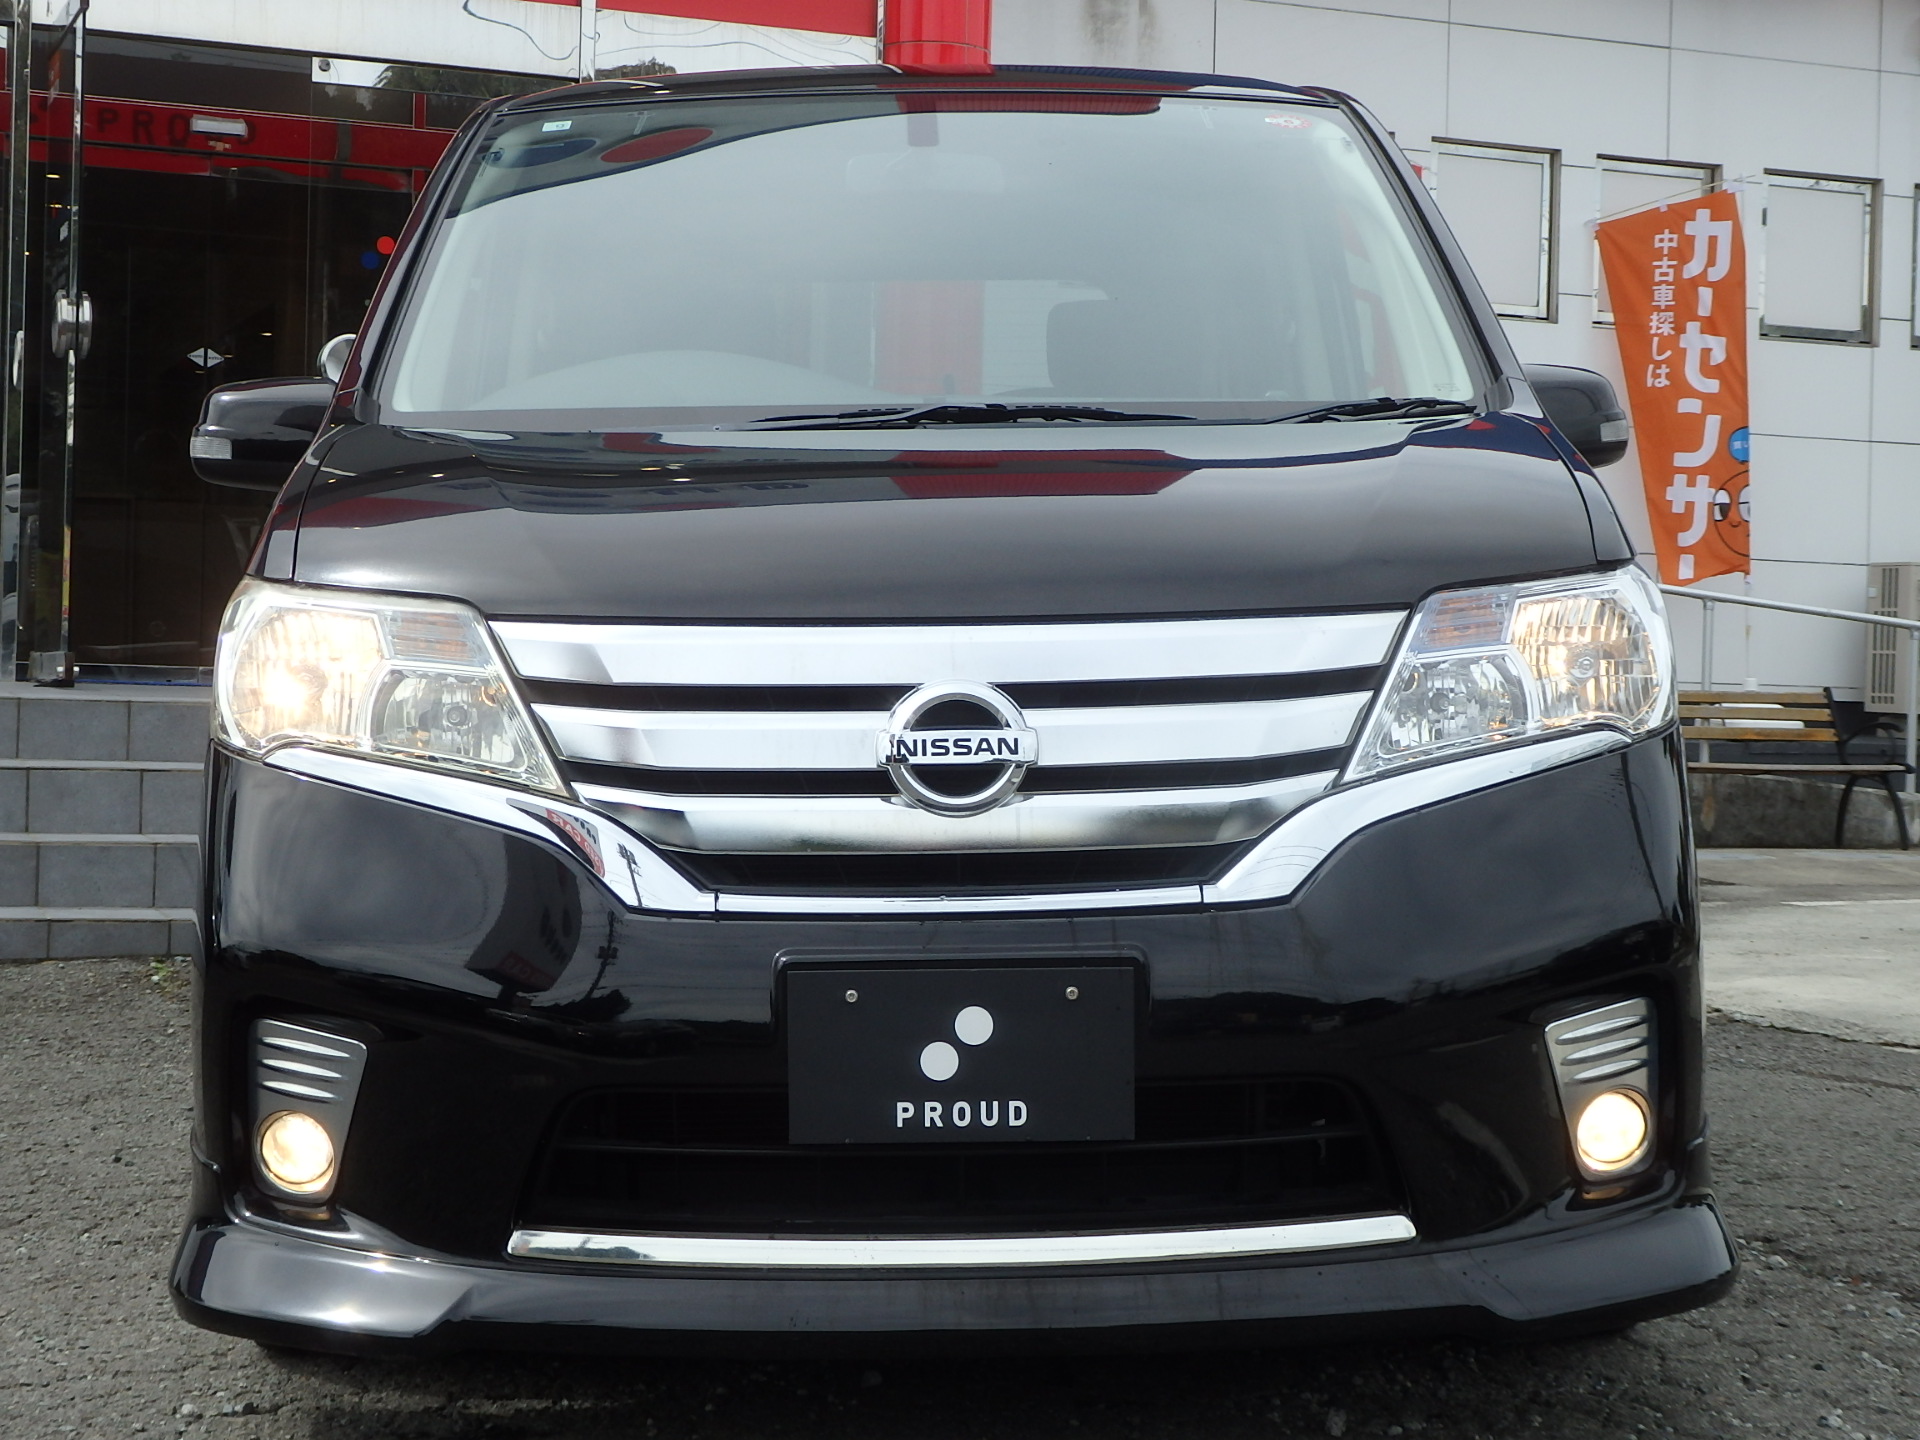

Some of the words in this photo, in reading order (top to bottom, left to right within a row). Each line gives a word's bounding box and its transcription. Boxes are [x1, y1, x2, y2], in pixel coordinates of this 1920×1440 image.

[97, 107, 257, 147] PROD
[1646, 229, 1679, 388] 中古車探しは
[1666, 208, 1733, 580] カーセンサー
[896, 737, 1019, 757] NISSAN
[896, 1100, 1028, 1128] PROUD
